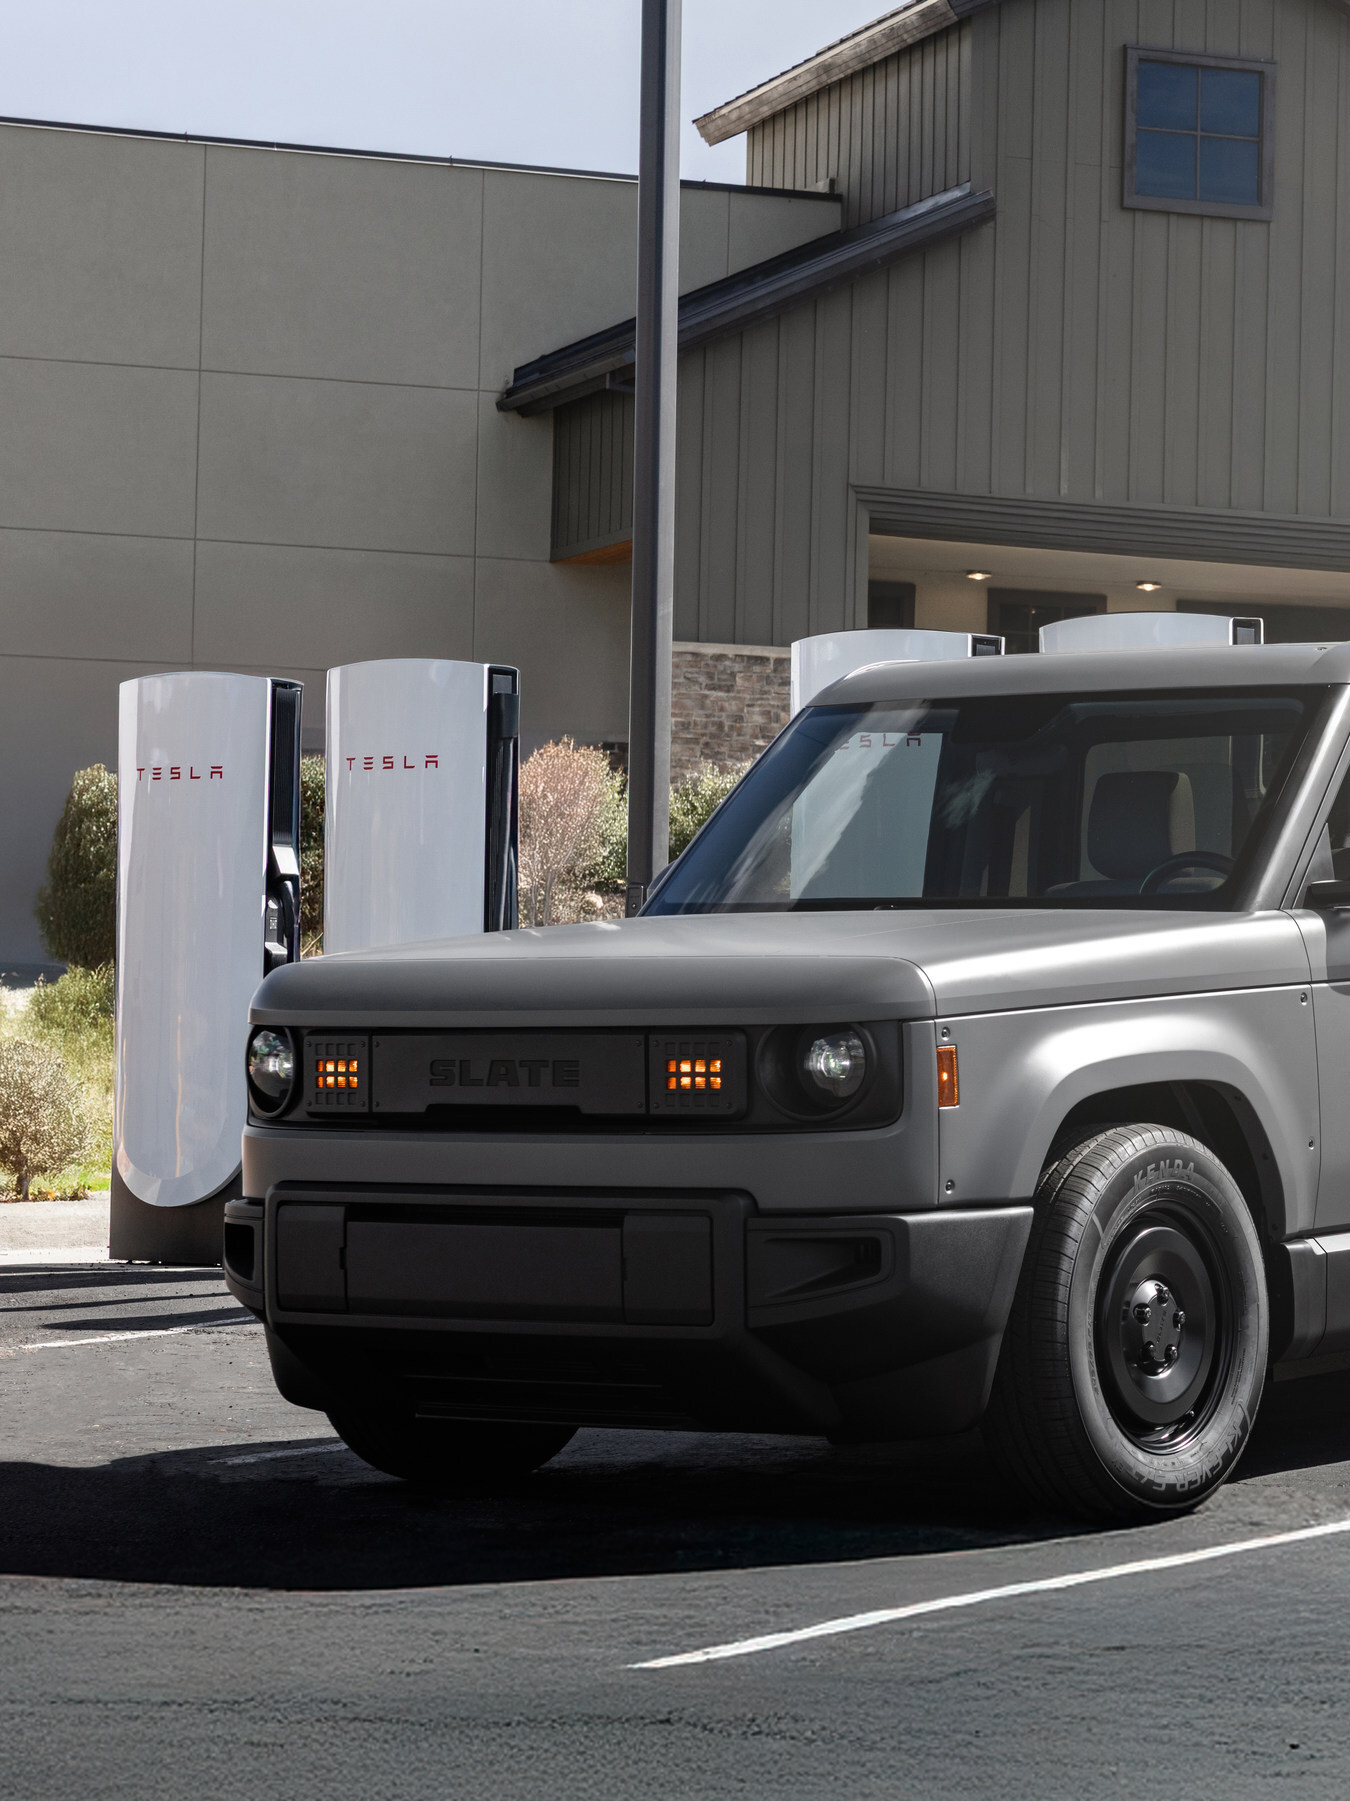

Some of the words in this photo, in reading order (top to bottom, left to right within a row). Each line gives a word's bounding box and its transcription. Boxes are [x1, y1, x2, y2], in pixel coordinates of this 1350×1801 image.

[839, 732, 921, 750] SLA
[137, 766, 223, 781] TESLA
[347, 755, 438, 771] TESLA
[429, 1059, 580, 1087] SLATE
[1133, 1159, 1195, 1190] KENDA
[1175, 1423, 1242, 1492] KLEVER
